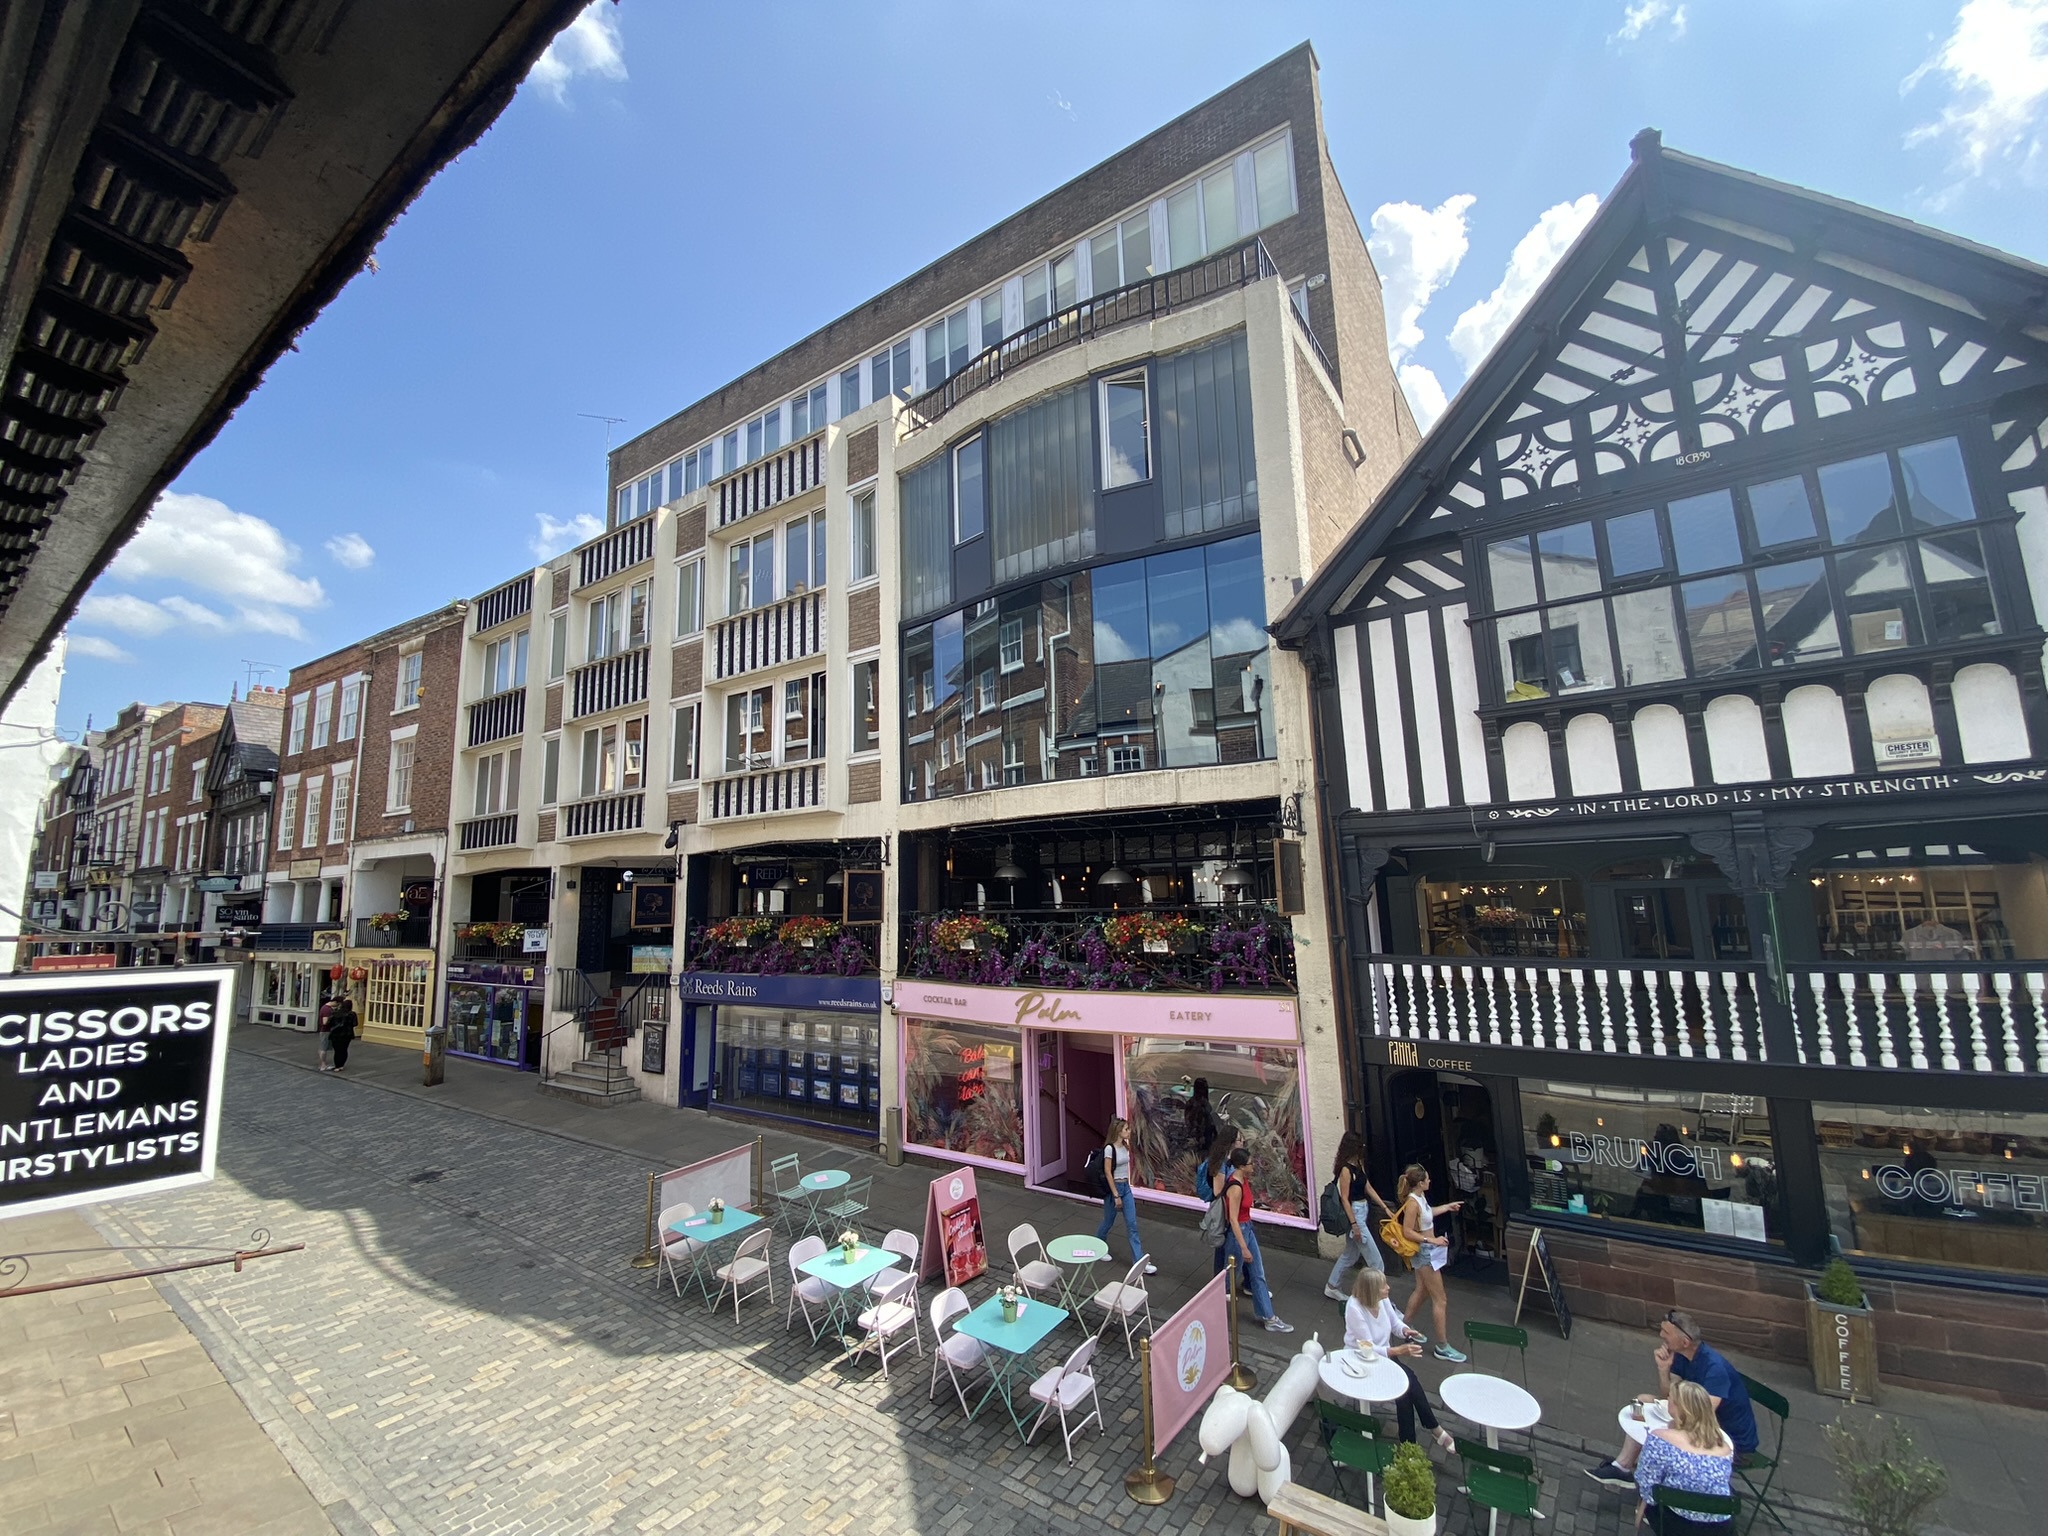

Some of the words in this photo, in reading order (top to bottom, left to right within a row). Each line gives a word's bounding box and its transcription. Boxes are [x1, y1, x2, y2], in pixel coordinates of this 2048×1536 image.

[1887, 741, 1929, 752] CHESTER
[1576, 801, 1596, 815] IN
[1609, 798, 1650, 812] THE
[1664, 793, 1719, 808] LORD
[1734, 790, 1752, 803] IS
[1772, 786, 1806, 800] MY
[1820, 775, 1951, 796] STRENGTH
[695, 978, 724, 996] Reeds
[728, 980, 757, 998] Rains
[923, 994, 952, 1006] COCKTAIL
[954, 998, 967, 1006] BAR
[818, 999, 877, 1009] www.reedsrains.co.uk
[1014, 991, 1082, 1024] Palm
[1169, 1010, 1212, 1021] EATERY
[1278, 1002, 1292, 1012] 31
[0, 1002, 213, 1046] CISSORS
[18, 1041, 149, 1074] LADIES
[1428, 1058, 1472, 1072] COFFEE
[38, 1078, 122, 1107] AND
[1, 1100, 200, 1146] NTLEMANS
[1570, 1132, 1723, 1181] BRUNCH
[1876, 1164, 2048, 1213] COFFE
[1835, 1314, 1851, 1391] COFFEE
